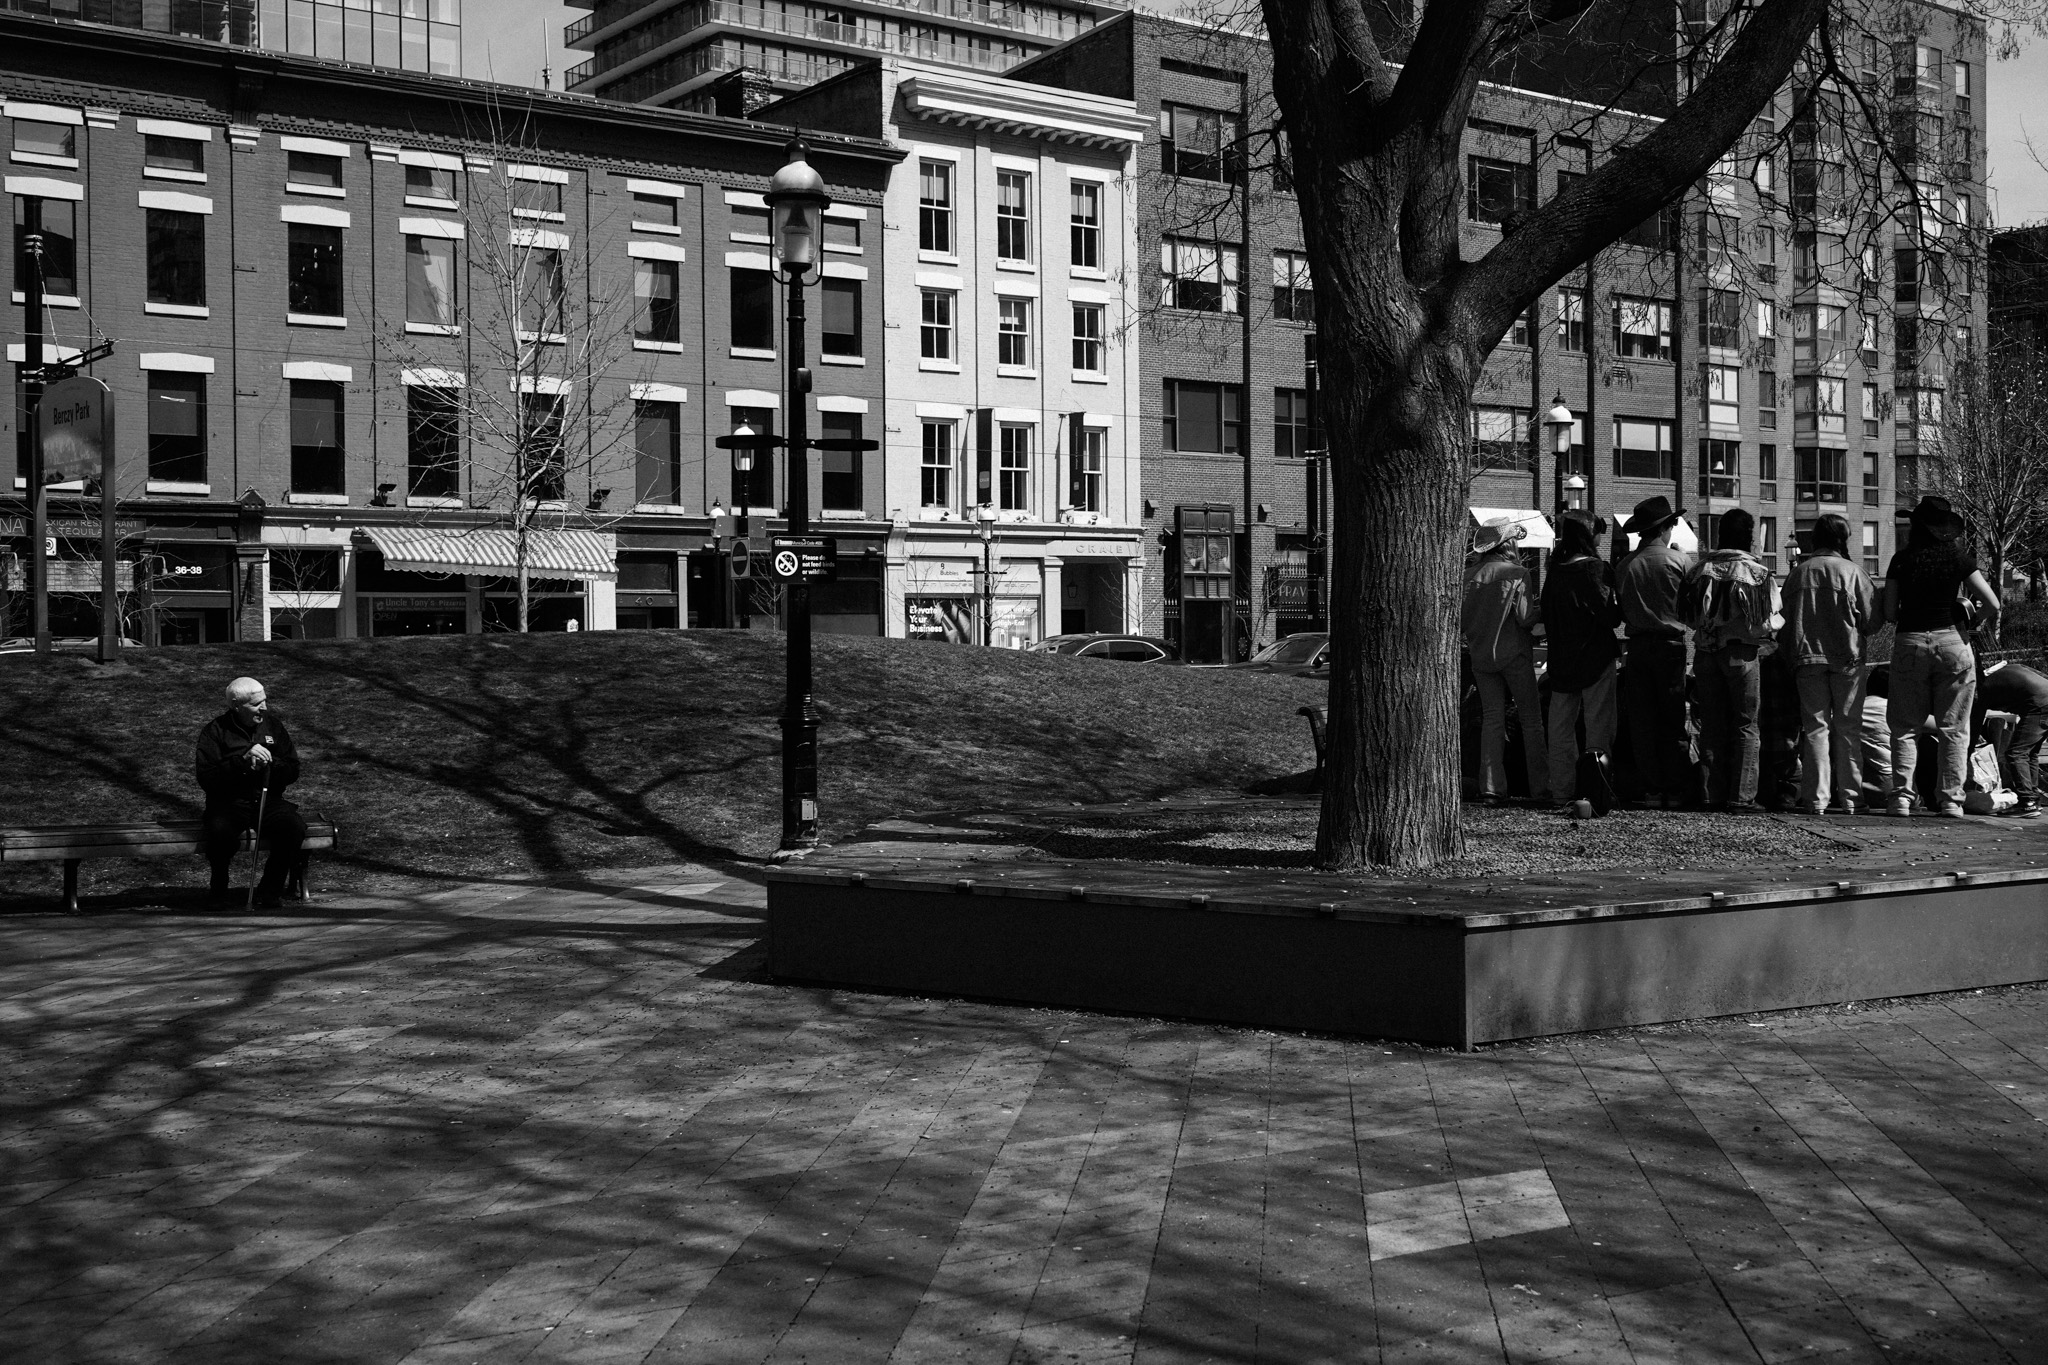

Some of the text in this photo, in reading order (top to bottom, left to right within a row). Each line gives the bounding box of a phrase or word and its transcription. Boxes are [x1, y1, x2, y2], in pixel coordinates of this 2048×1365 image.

[53, 400, 90, 427] Berczy Park
[175, 565, 203, 575] 36-38
[939, 569, 960, 577] Bubbles
[385, 598, 466, 607] Uncle Tony's Pizzeria
[373, 612, 398, 622] OPEN
[909, 623, 943, 633] Business
